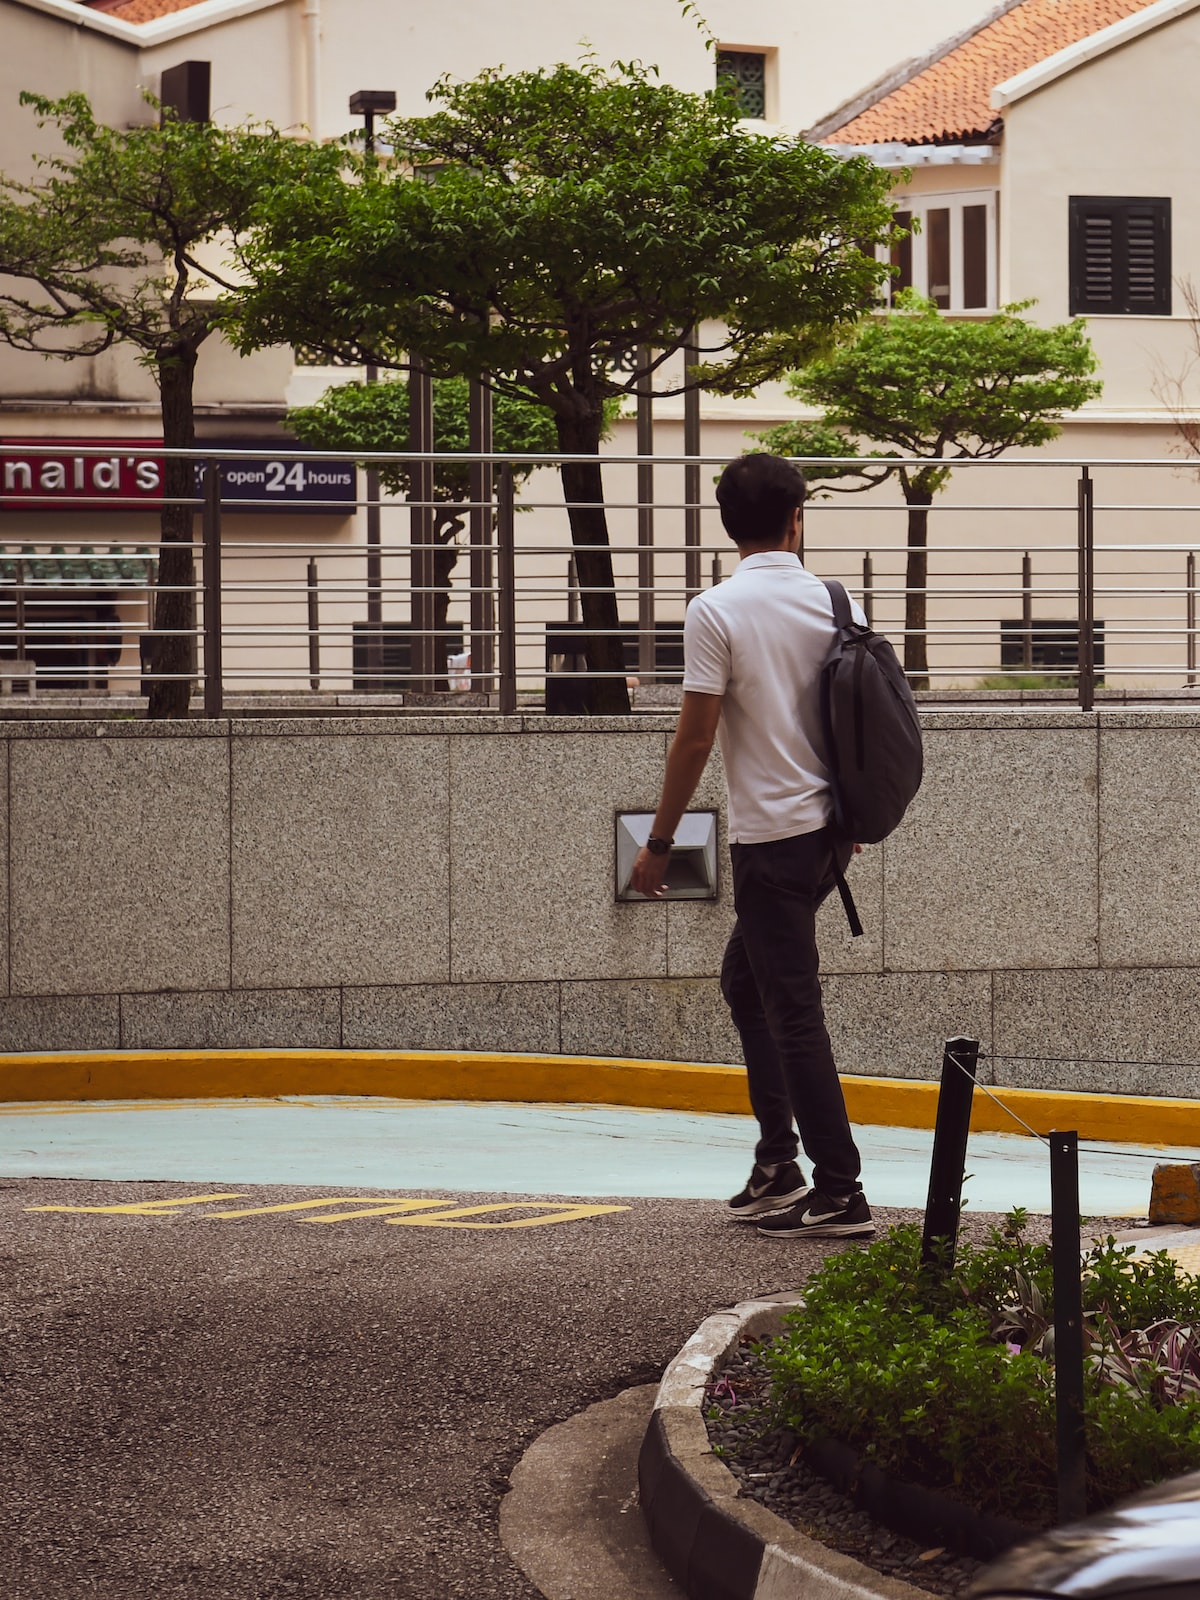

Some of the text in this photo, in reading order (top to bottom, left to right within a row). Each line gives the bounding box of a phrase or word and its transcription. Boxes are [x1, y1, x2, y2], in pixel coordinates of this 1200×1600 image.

[226, 471, 265, 485] open
[265, 461, 307, 492] 24
[308, 470, 351, 485] hours
